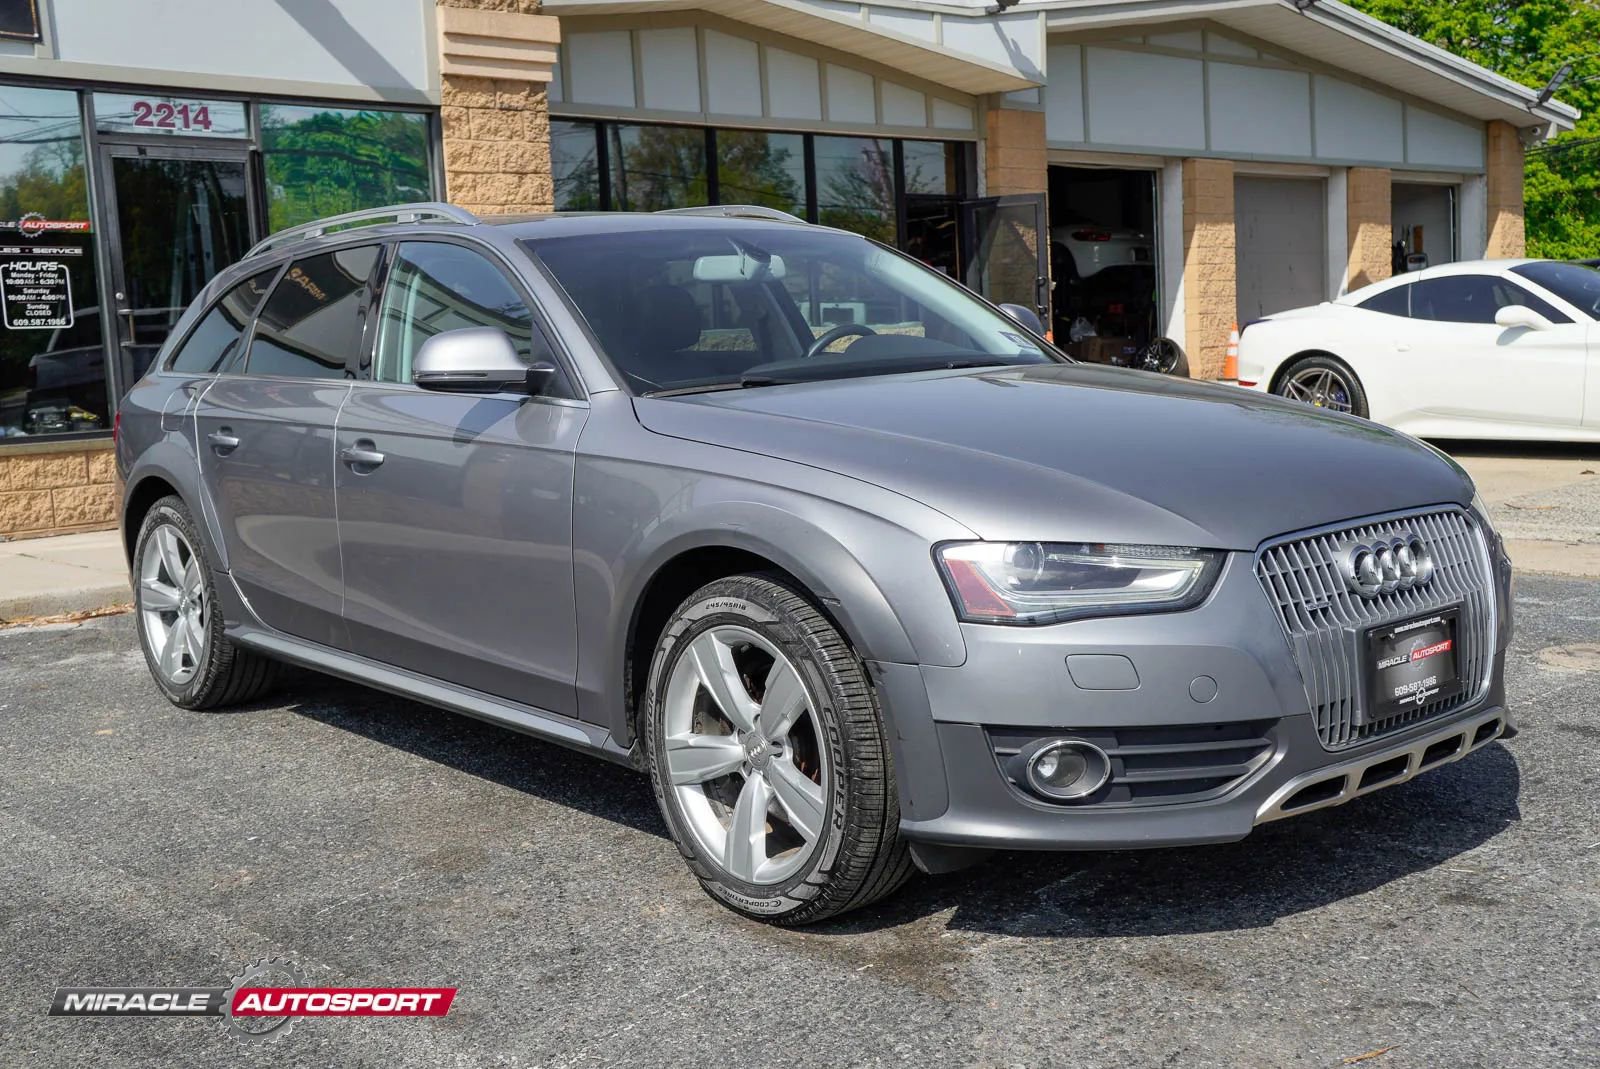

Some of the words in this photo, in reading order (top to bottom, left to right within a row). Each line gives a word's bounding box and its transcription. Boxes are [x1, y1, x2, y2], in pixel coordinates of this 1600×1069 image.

[133, 101, 212, 130] 2214
[23, 221, 87, 229] AUTOSPORT
[9, 261, 59, 271] HOURS
[13, 318, 67, 326] 609.587.1986
[1378, 655, 1408, 670] MIRACLE
[1412, 642, 1449, 660] AUTOSPORT
[1394, 676, 1437, 697] 609-587-1986
[823, 707, 845, 830] COOPER
